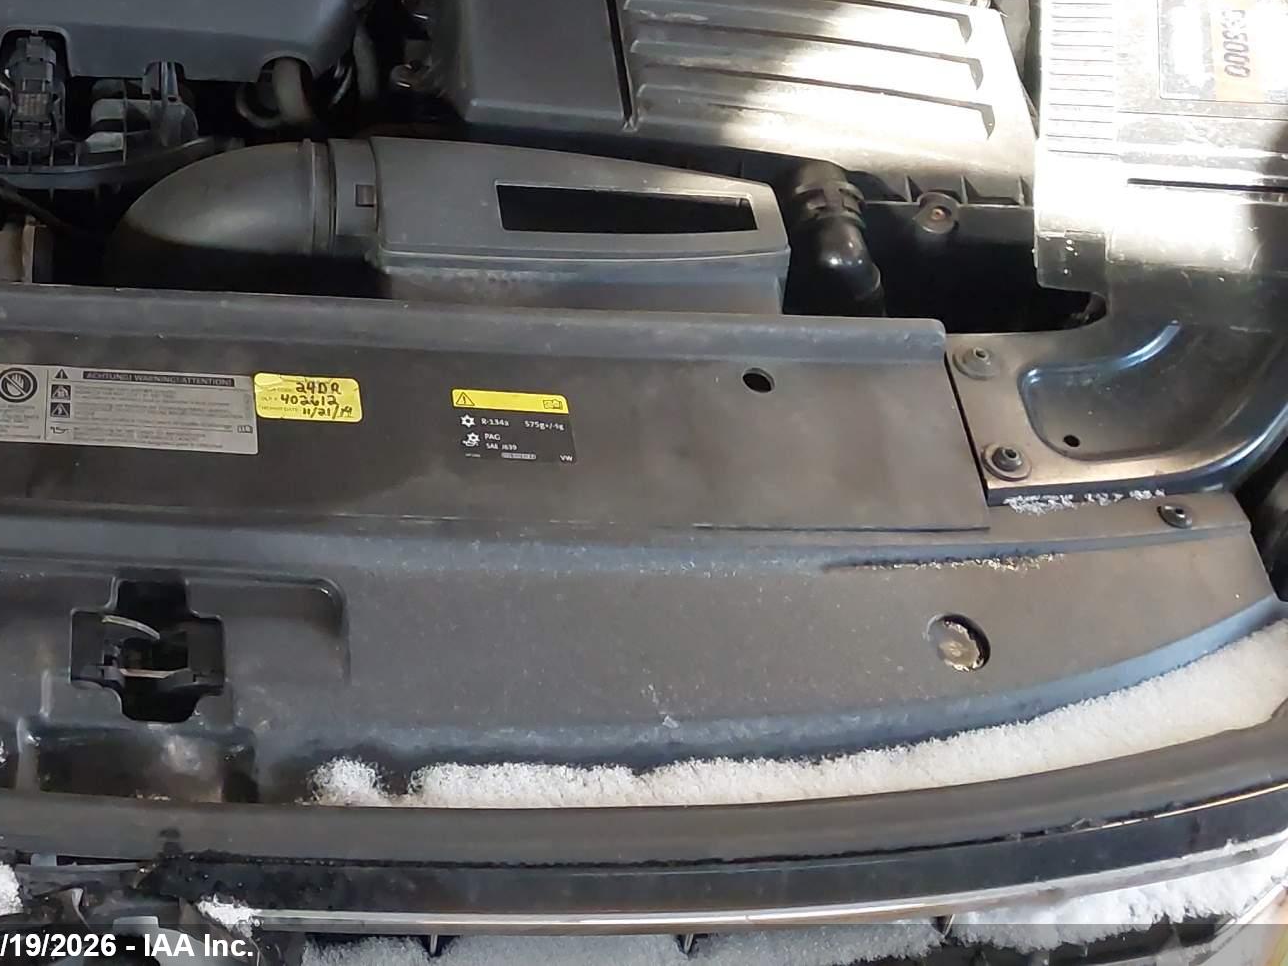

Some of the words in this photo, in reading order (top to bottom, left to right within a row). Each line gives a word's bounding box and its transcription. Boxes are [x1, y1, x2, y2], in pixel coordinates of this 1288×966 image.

[280, 394, 340, 406] 402612
[481, 417, 510, 427] R-134a
[484, 433, 501, 441] PAG
[559, 454, 573, 462] VW
